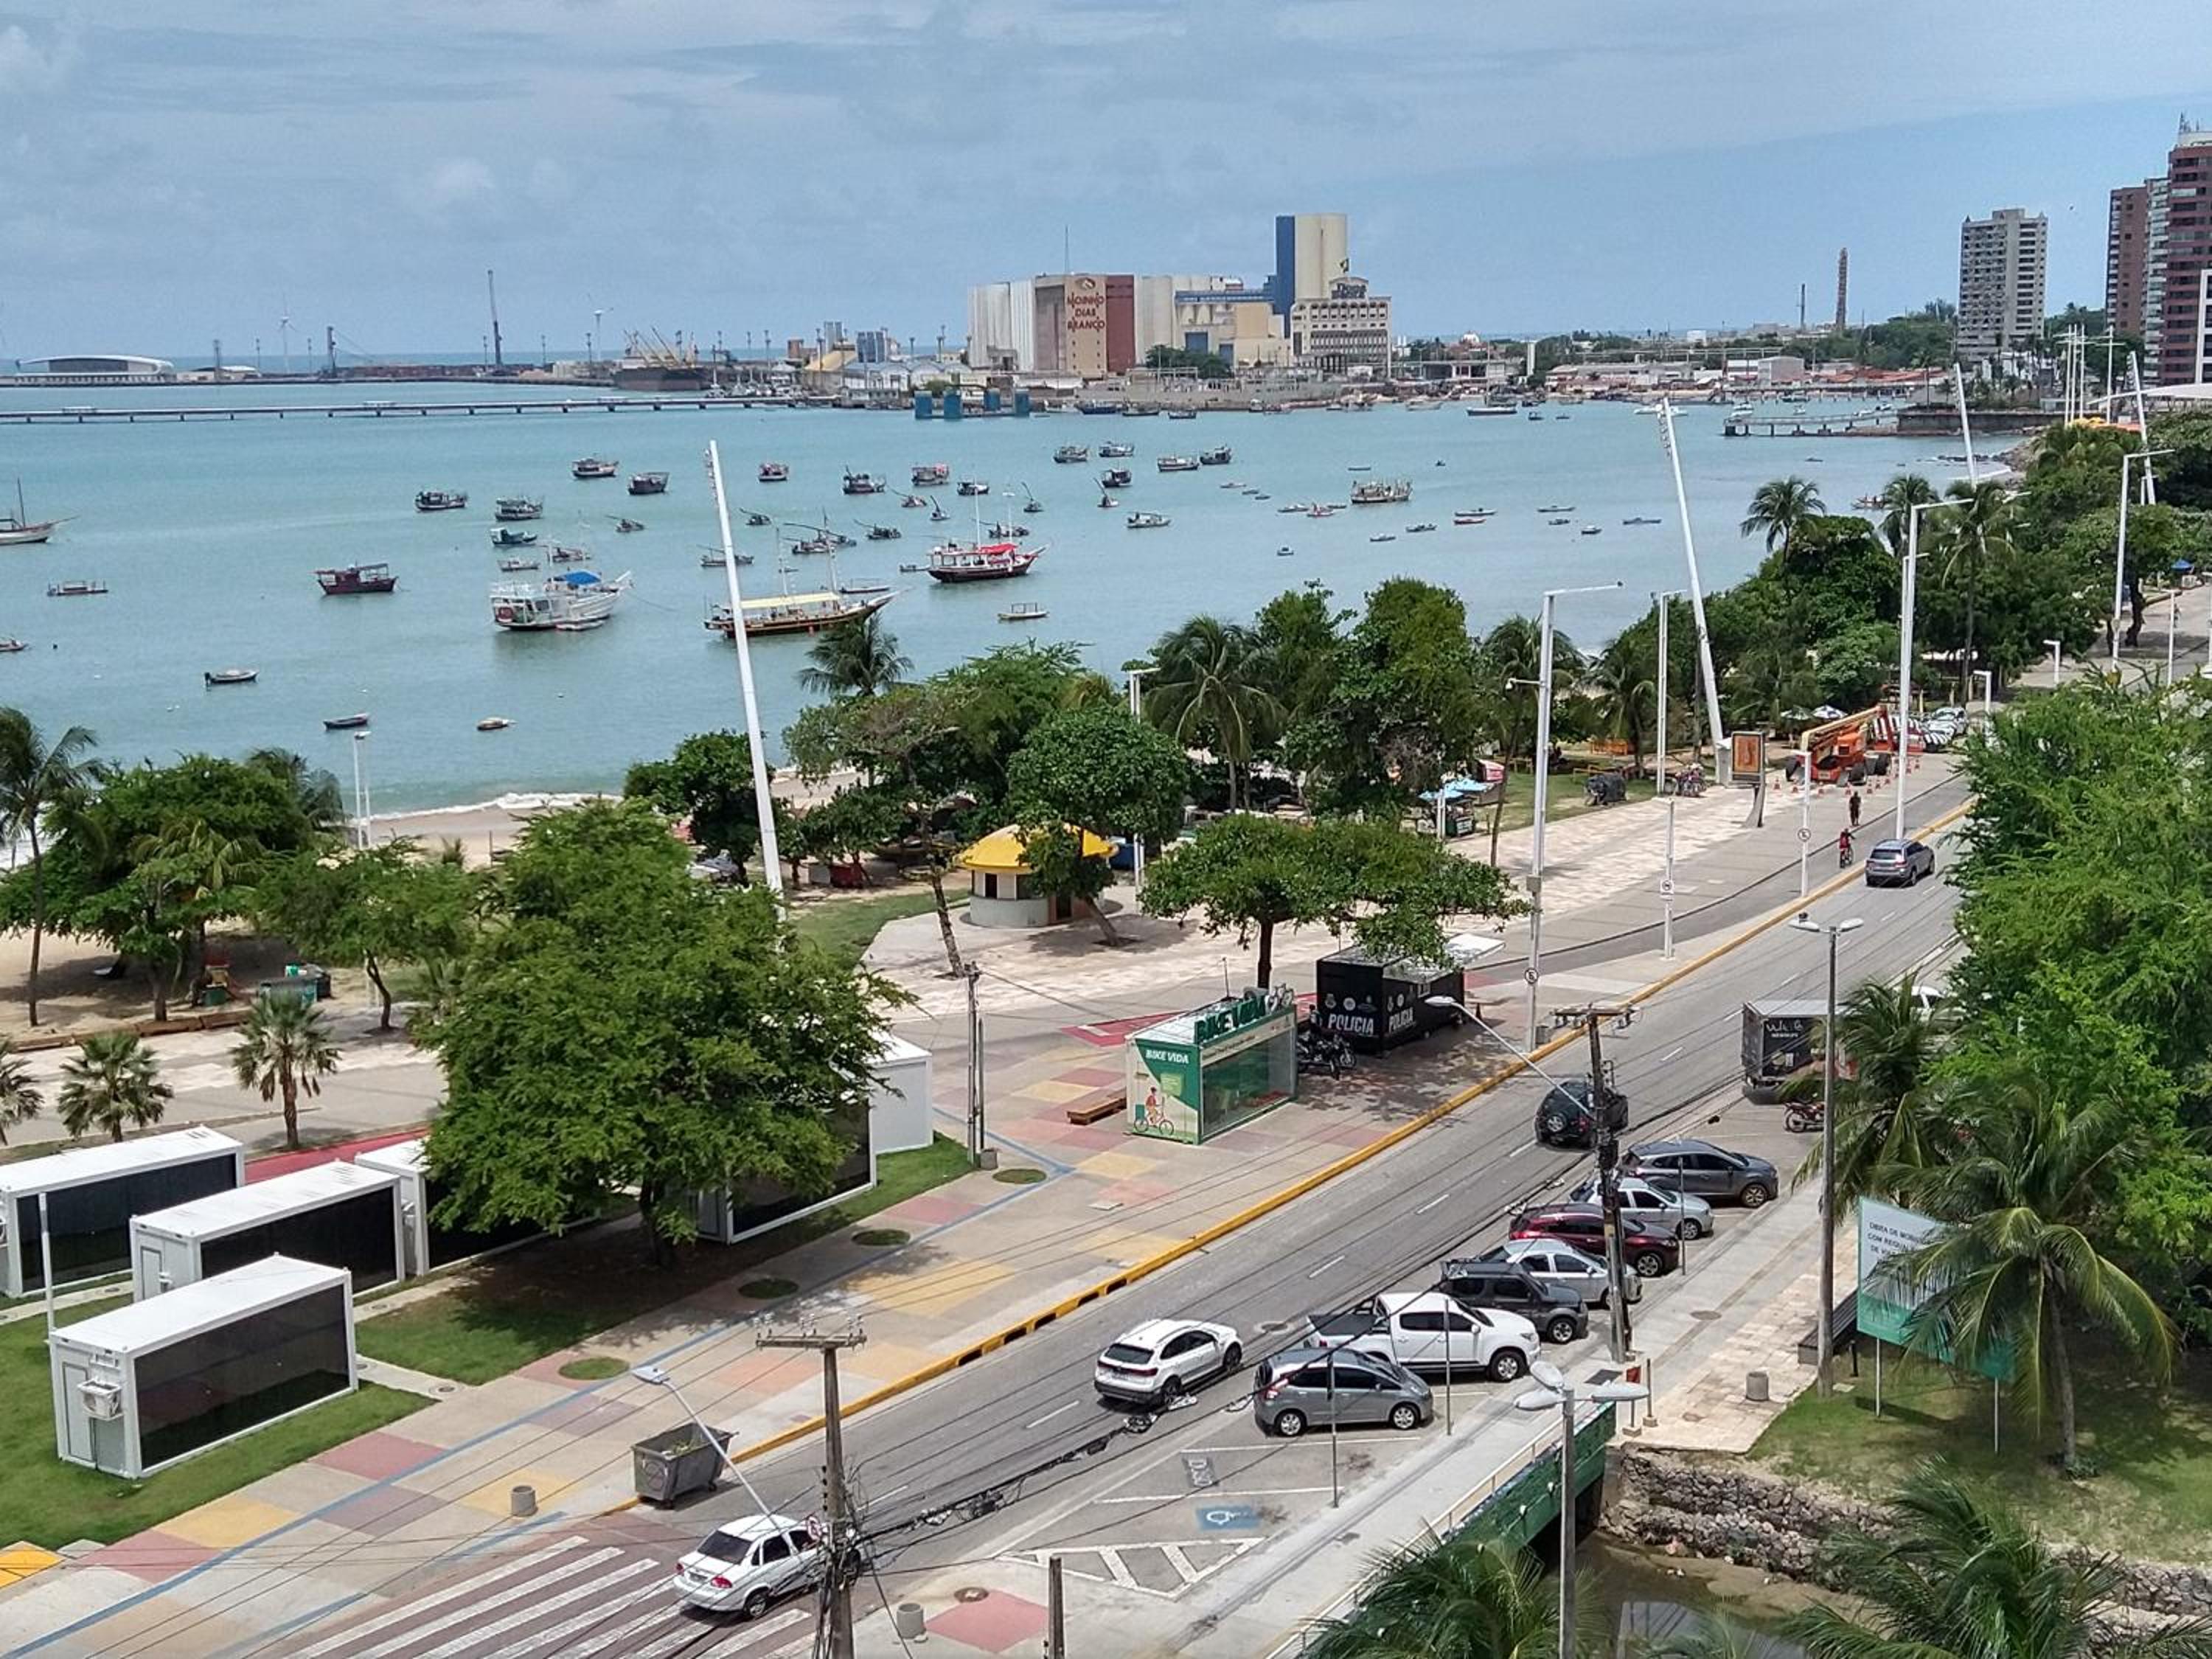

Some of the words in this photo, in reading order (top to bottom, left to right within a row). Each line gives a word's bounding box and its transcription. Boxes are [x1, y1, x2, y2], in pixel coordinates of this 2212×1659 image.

[1067, 293, 1105, 307] MOINHO
[1074, 308, 1096, 317] DIAS
[1067, 317, 1105, 333] BRANCO
[1194, 1008, 1233, 1043] BIKE
[1145, 1049, 1167, 1061] BIKE
[1167, 1051, 1189, 1064] VIDA
[1868, 1232, 1882, 1242] COM
[1869, 1222, 1888, 1233] OBRA
[1889, 1228, 1899, 1237] DE
